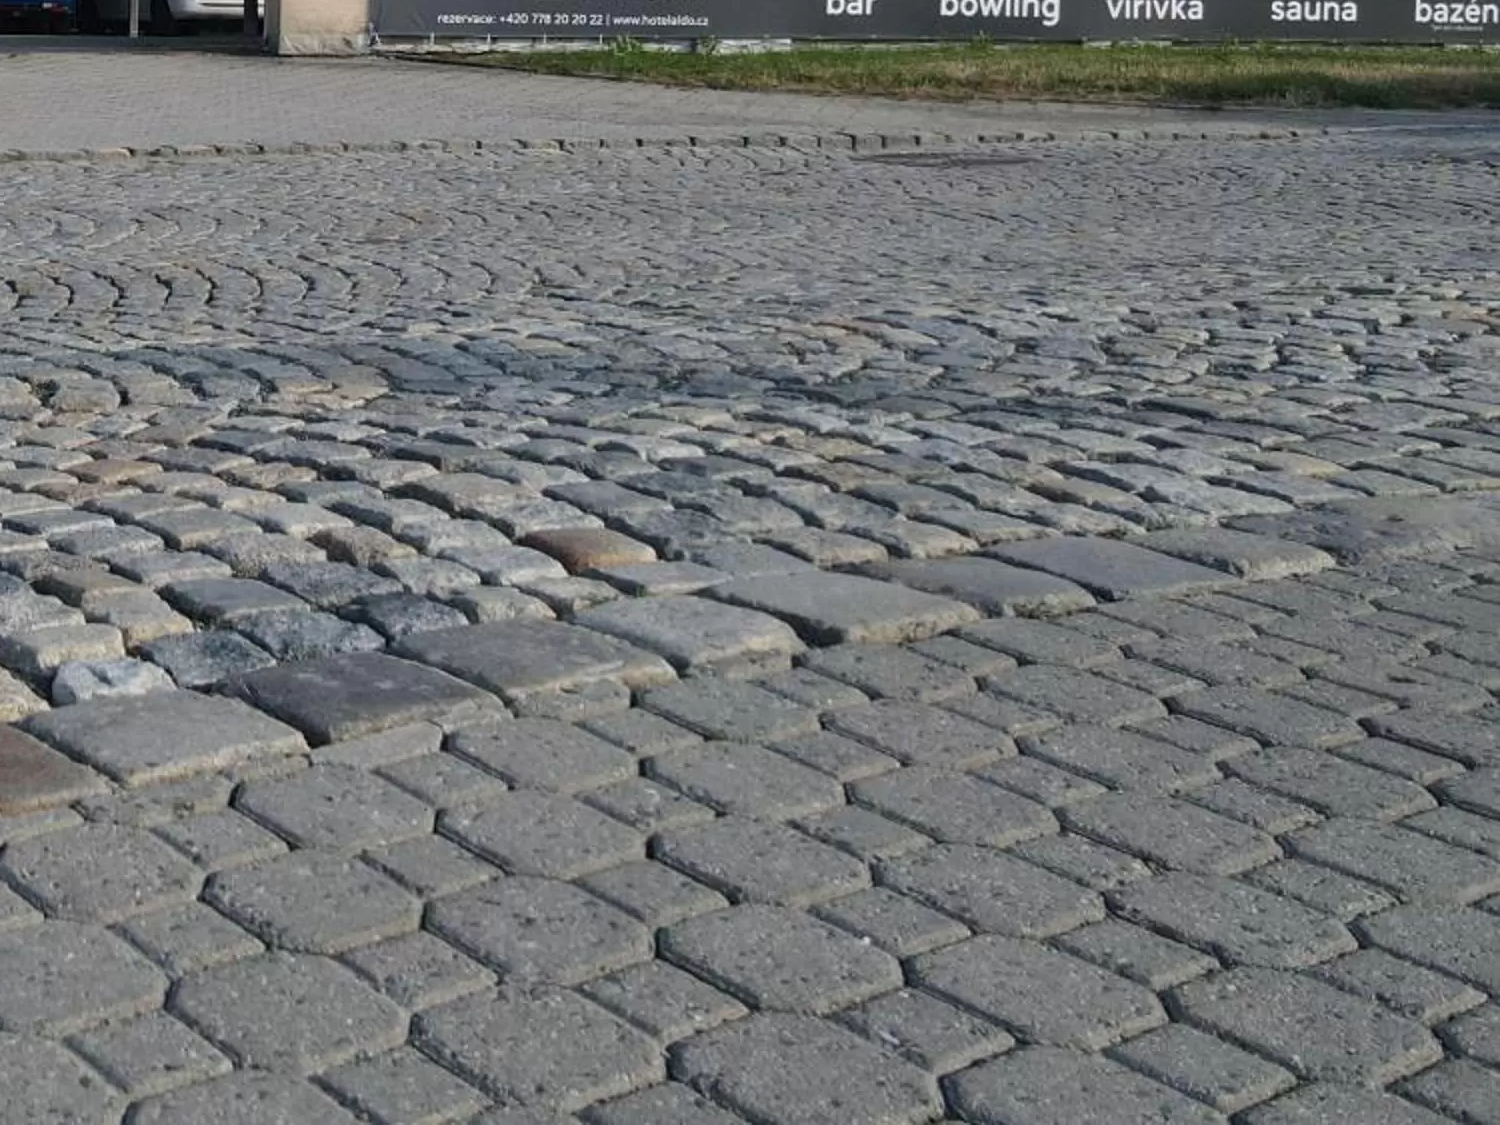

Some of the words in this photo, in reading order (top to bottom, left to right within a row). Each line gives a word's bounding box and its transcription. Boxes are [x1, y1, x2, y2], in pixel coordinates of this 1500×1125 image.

[1272, 1, 1356, 21] sauna
[554, 14, 569, 24] 20
[572, 14, 587, 25] 20
